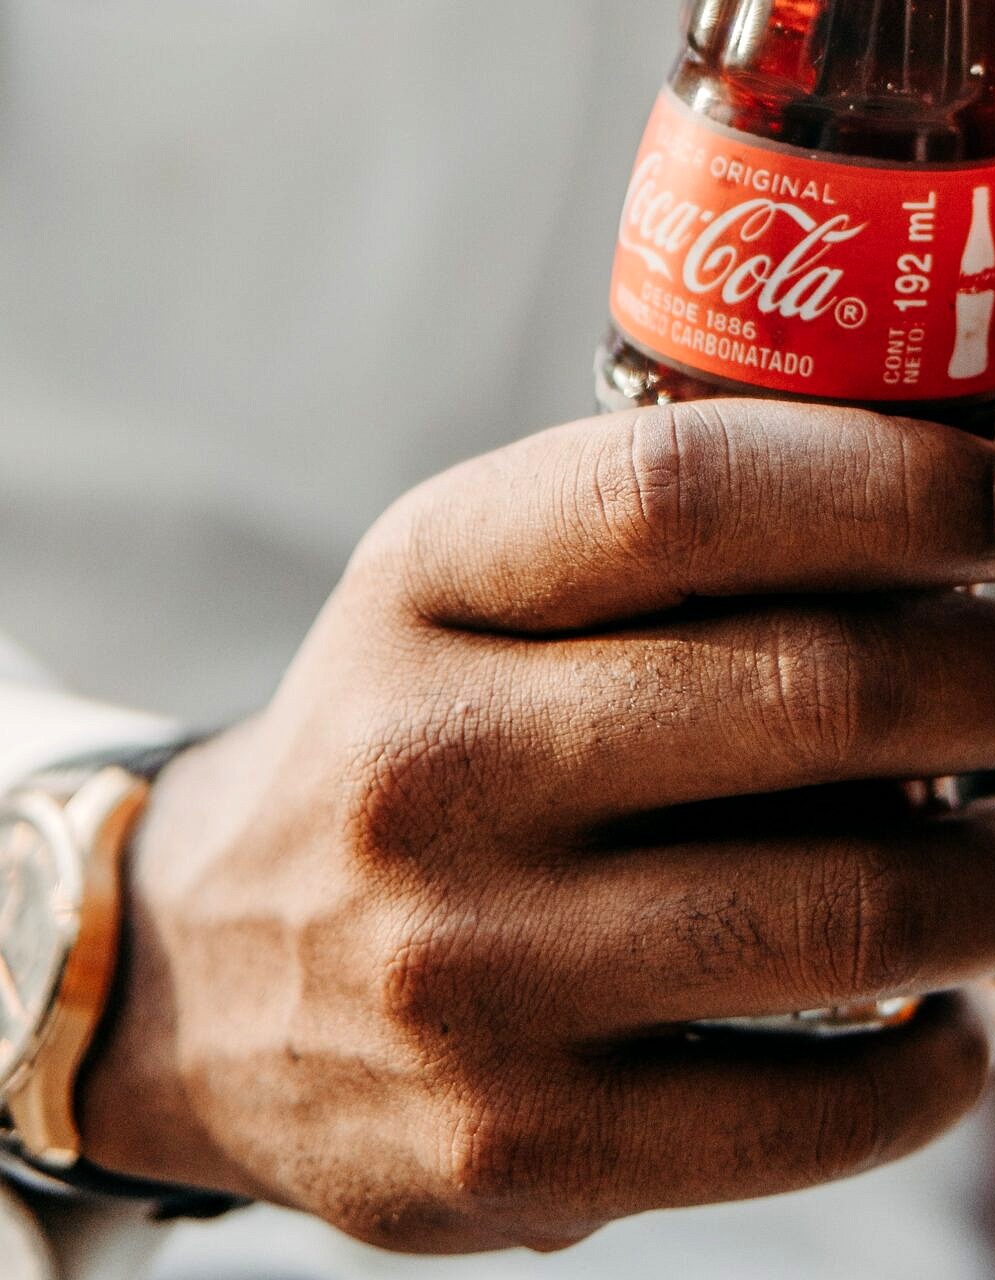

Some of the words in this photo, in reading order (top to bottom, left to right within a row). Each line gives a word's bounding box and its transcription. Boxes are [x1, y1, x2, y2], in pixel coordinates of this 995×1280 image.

[710, 155, 837, 205] ORIGINAL
[902, 191, 936, 242] mL
[641, 282, 699, 323] DESDE
[705, 309, 757, 340] 1886
[893, 253, 933, 312] 192
[671, 320, 814, 378] CARBONATADO
